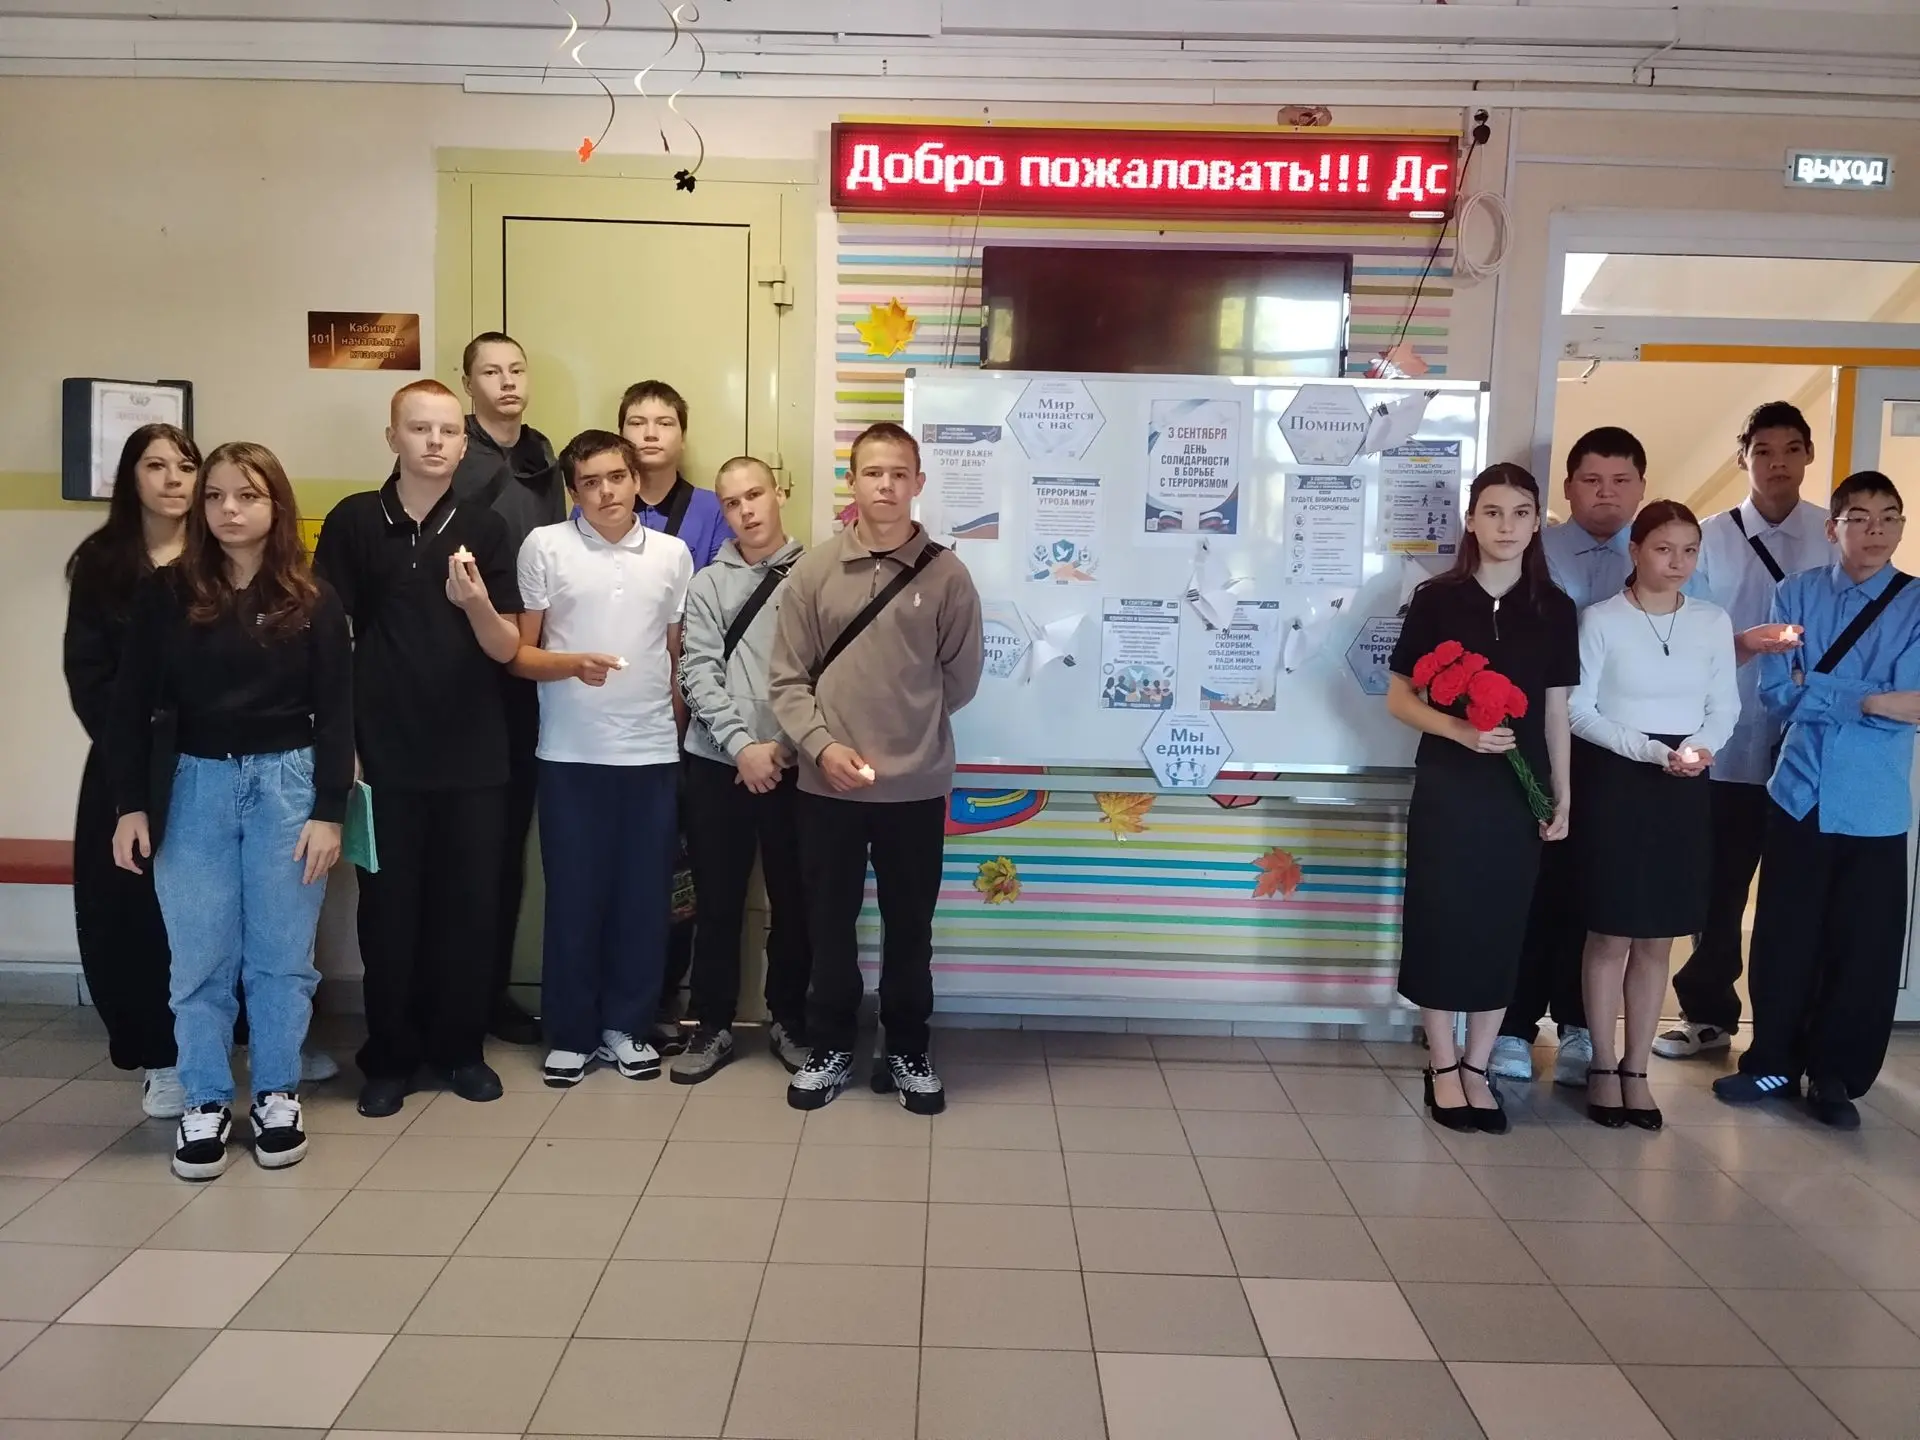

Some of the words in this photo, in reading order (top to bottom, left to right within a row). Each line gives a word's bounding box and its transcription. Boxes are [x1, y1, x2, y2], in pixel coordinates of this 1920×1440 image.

[847, 142, 1005, 193] Добро
[1020, 154, 1369, 195] пожаловать!!!
[1797, 157, 1884, 184] ВЫХОД
[349, 322, 397, 334] Кабинет
[311, 334, 330, 344] 101
[341, 337, 405, 347] начальных
[350, 350, 397, 360] классов
[1038, 398, 1075, 413] Мир
[1018, 411, 1094, 420] начинается
[1037, 421, 1045, 429] с
[1050, 421, 1075, 430] нас
[1289, 415, 1365, 432] Помним
[1168, 426, 1175, 439] 3
[1177, 427, 1228, 440] СЕНТЯБРЯ
[933, 448, 964, 457] ПОЧЕМУ
[966, 449, 993, 457] ВАЖЕН
[1183, 444, 1207, 455] ДЕНЬ
[940, 458, 959, 466] ЭТОТ
[961, 459, 986, 467] ДЕНЬ?
[1161, 455, 1230, 466] СОЛИДАРНОСТИ
[1174, 467, 1180, 476] В
[1182, 467, 1215, 477] БОРЬБЕ
[1160, 478, 1166, 487] С
[1168, 478, 1229, 489] ТЕРРОРИЗМОМ
[1036, 487, 1088, 497] ТЕРРОРИЗМ
[1039, 498, 1070, 506] УГРОЗА
[1071, 499, 1095, 507] МИРУ
[1170, 727, 1204, 742] Мы
[1156, 744, 1220, 757] едины
